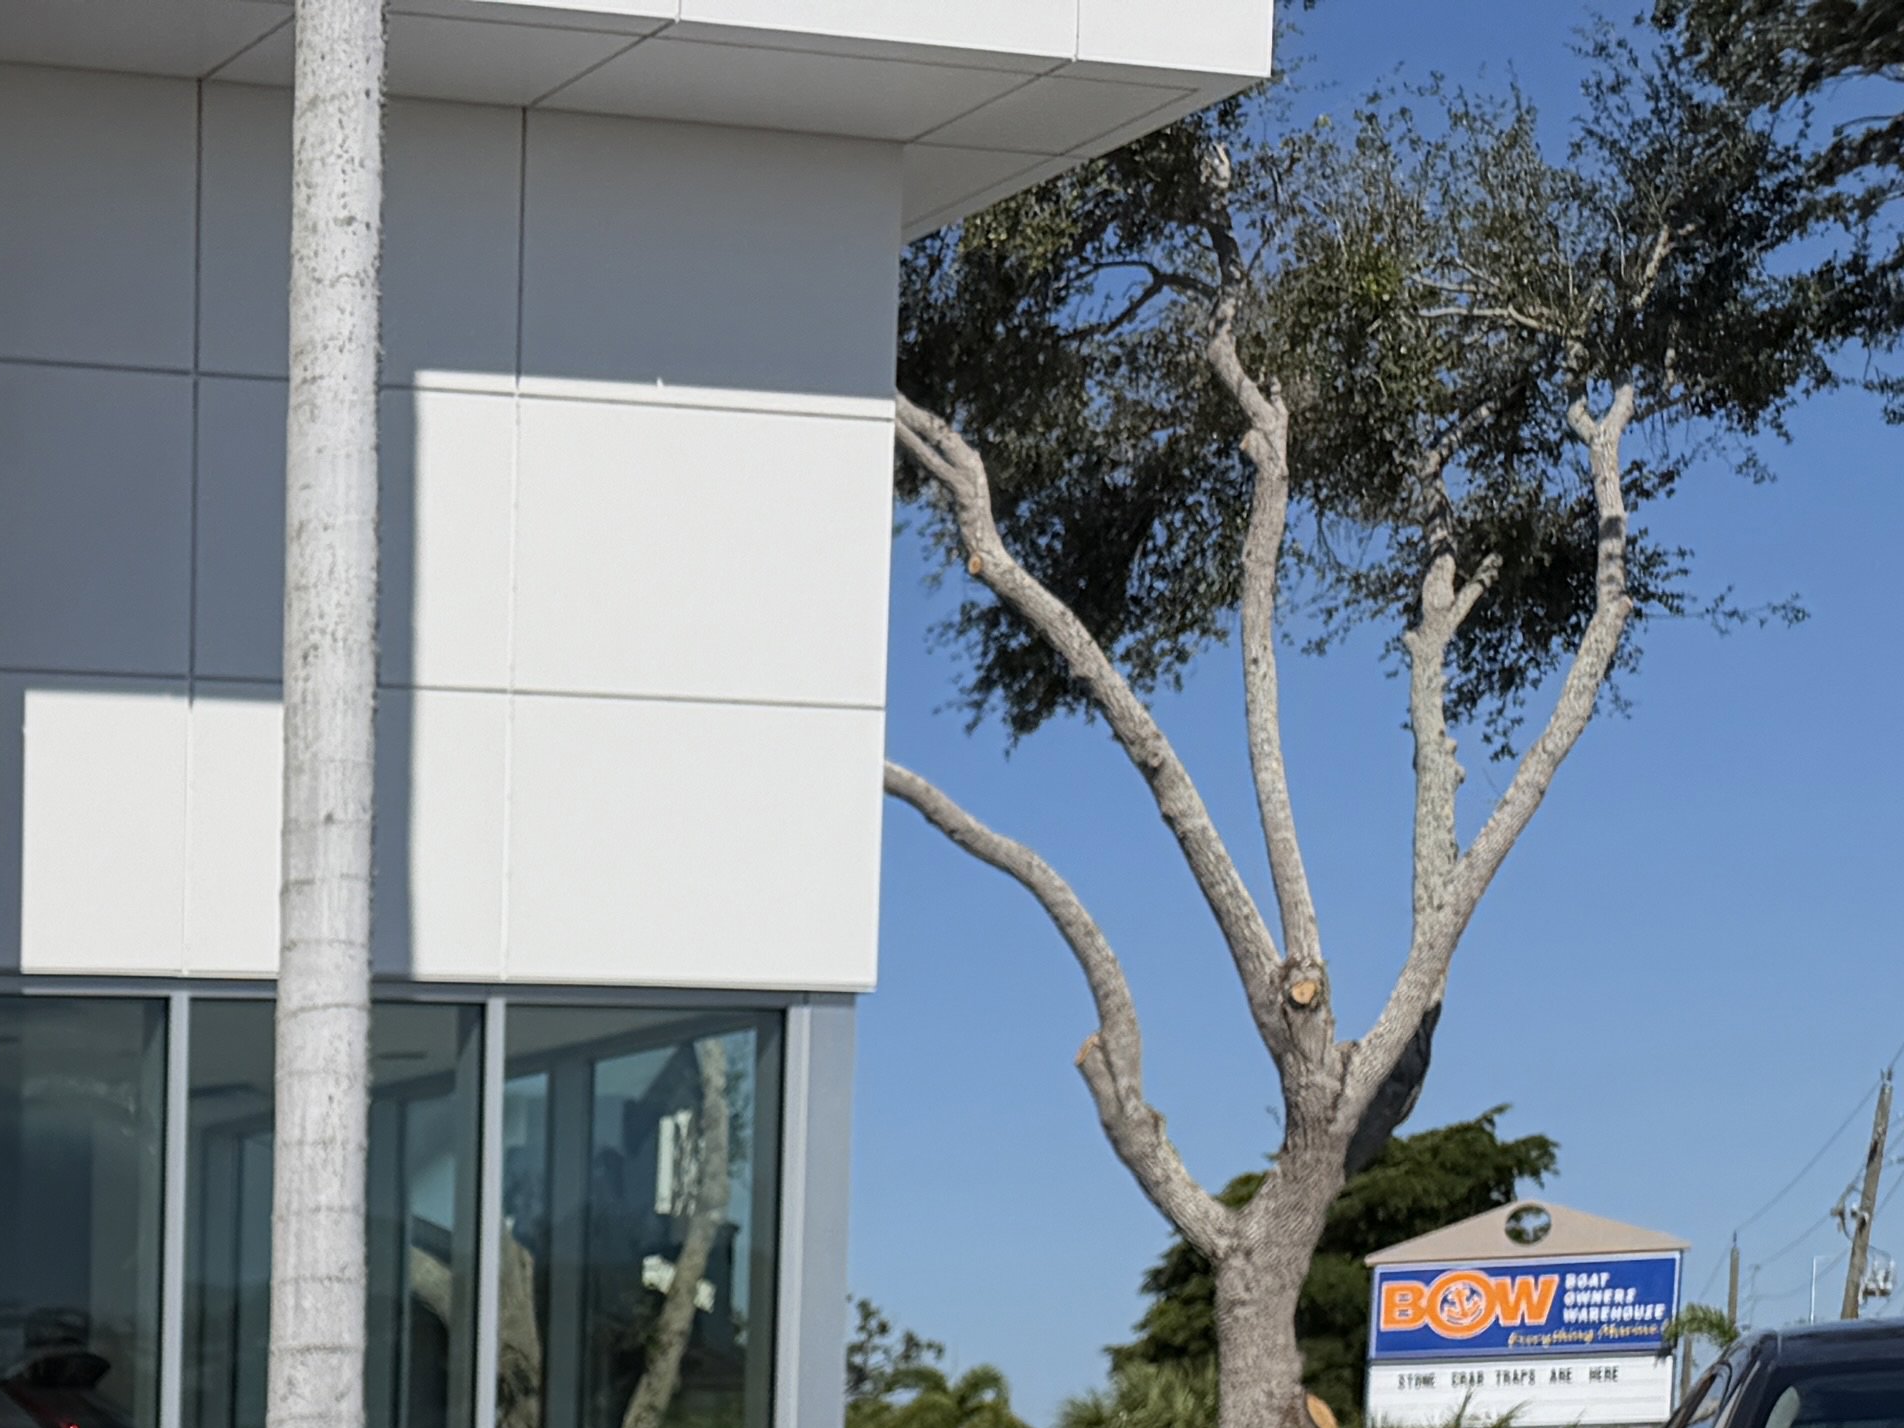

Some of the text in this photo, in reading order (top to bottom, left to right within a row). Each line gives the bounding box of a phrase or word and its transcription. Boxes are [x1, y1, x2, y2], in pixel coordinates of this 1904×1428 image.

[1565, 1271, 1610, 1289] BOAT
[1380, 1269, 1560, 1340] BOW
[1563, 1287, 1637, 1306] OWNERS
[1563, 1303, 1666, 1323] WAREHOUSE
[1496, 1368, 1536, 1387] TRAPS
[1549, 1367, 1573, 1385] ARE
[1589, 1365, 1620, 1383] HERE
